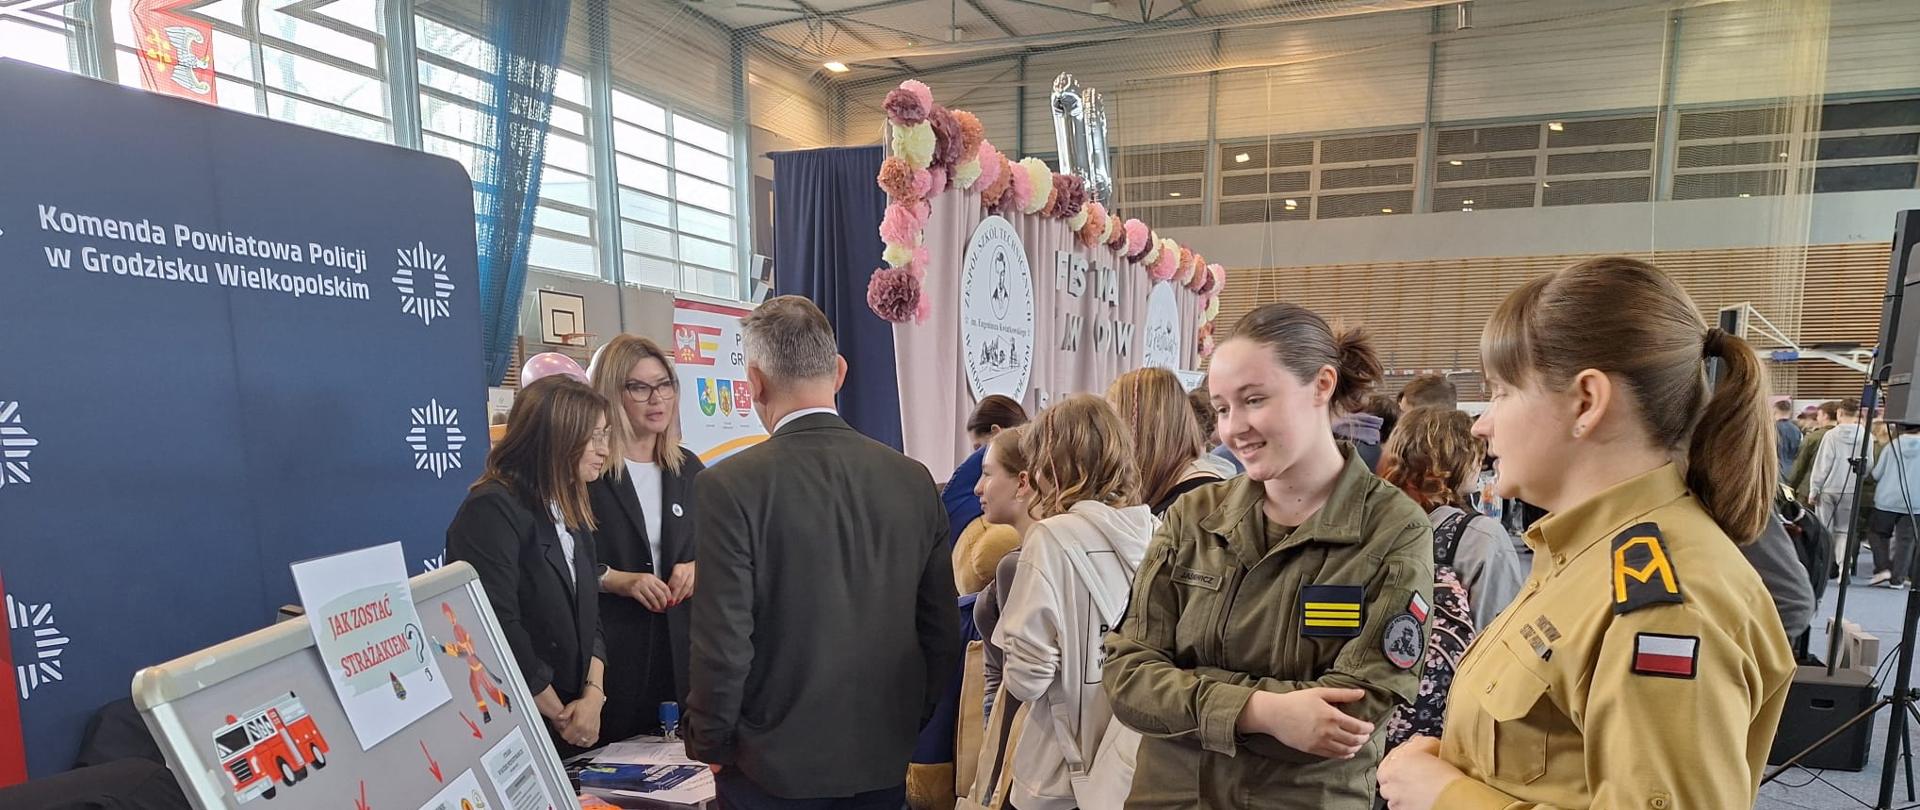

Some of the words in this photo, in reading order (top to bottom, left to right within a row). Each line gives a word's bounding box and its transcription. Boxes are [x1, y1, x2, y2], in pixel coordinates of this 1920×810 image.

[38, 204, 167, 245] Komenda
[174, 223, 303, 262] Powiatowa
[308, 242, 368, 274] Policji
[44, 246, 71, 269] w
[81, 246, 209, 284] Grodzisku
[214, 262, 370, 300] Wielkopolskim
[328, 610, 352, 641] JAK
[350, 592, 393, 630] ZOSTAĆ
[340, 632, 411, 678] STRAŻAKIEM
